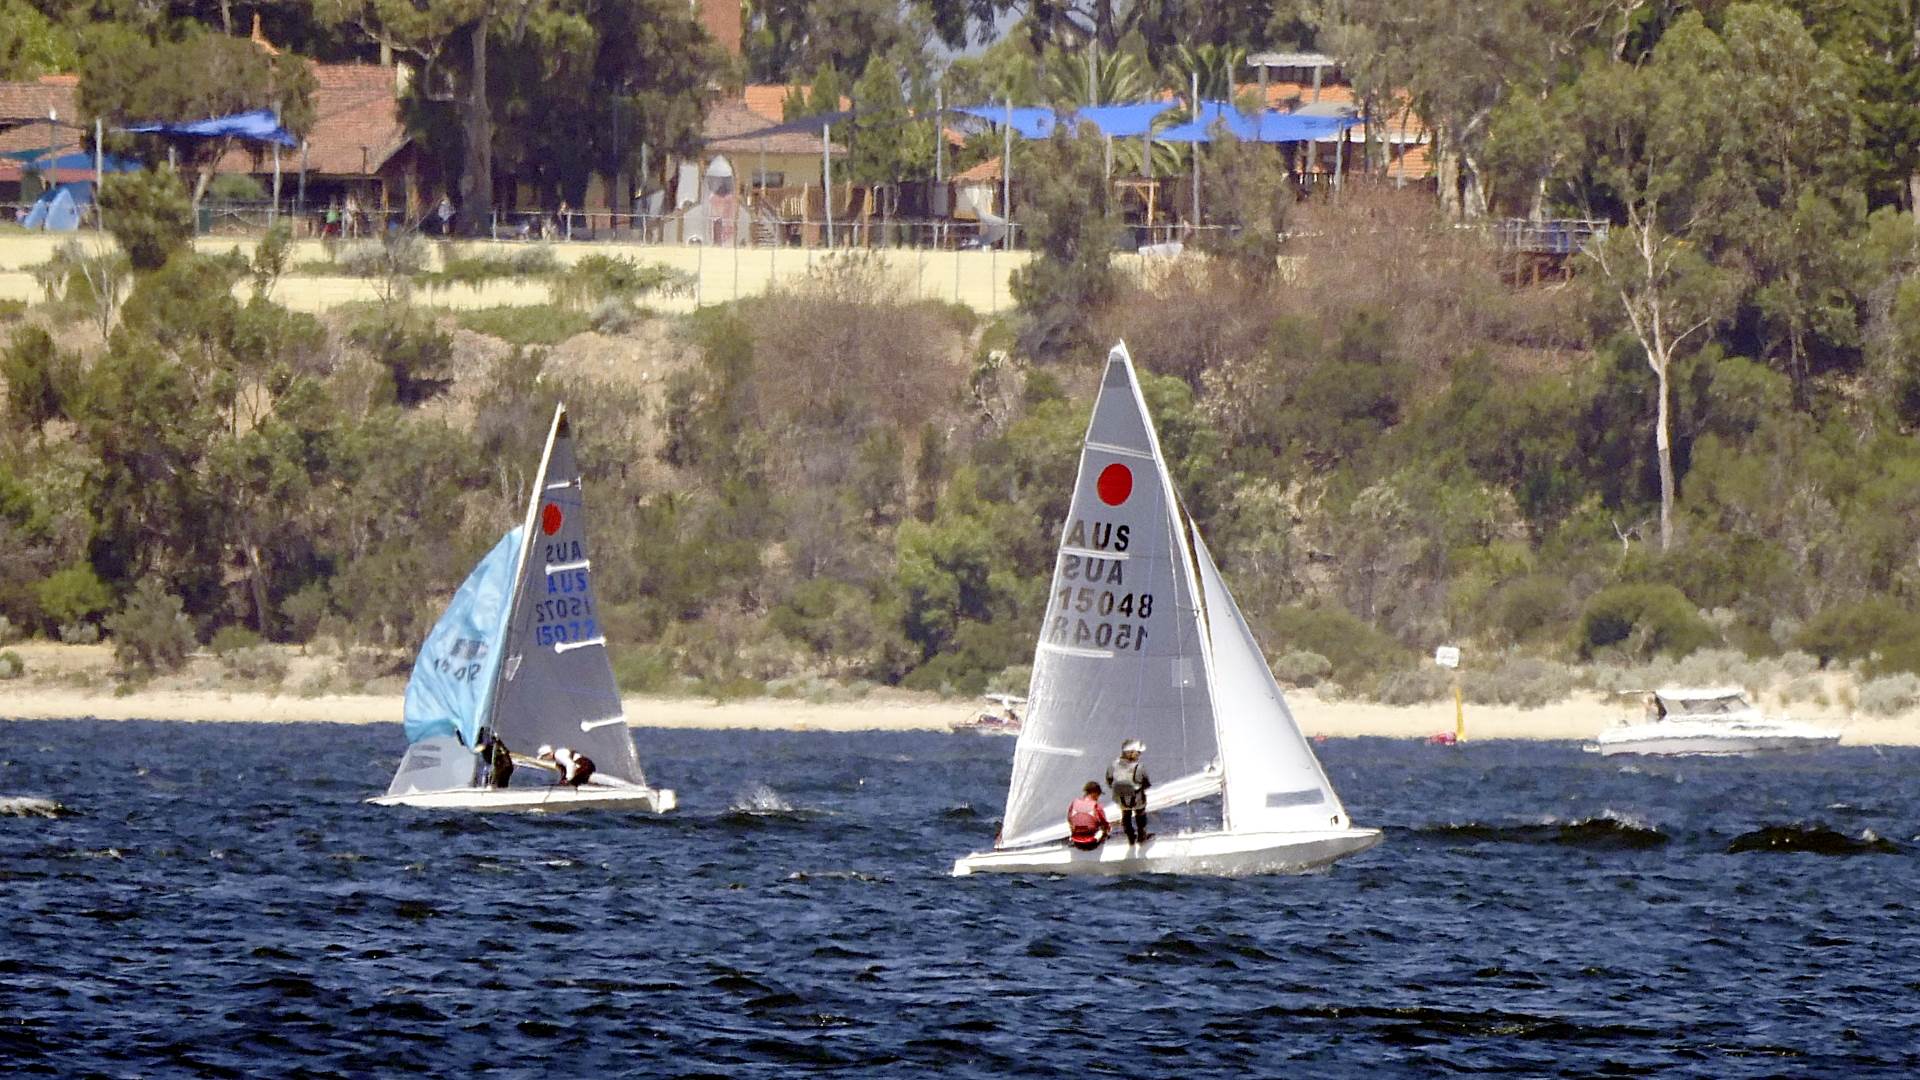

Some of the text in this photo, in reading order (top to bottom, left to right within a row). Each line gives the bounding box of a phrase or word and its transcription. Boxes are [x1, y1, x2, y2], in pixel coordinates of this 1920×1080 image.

[1066, 520, 1130, 552] AUS
[547, 572, 587, 595] AUS
[1057, 586, 1154, 619] 15048
